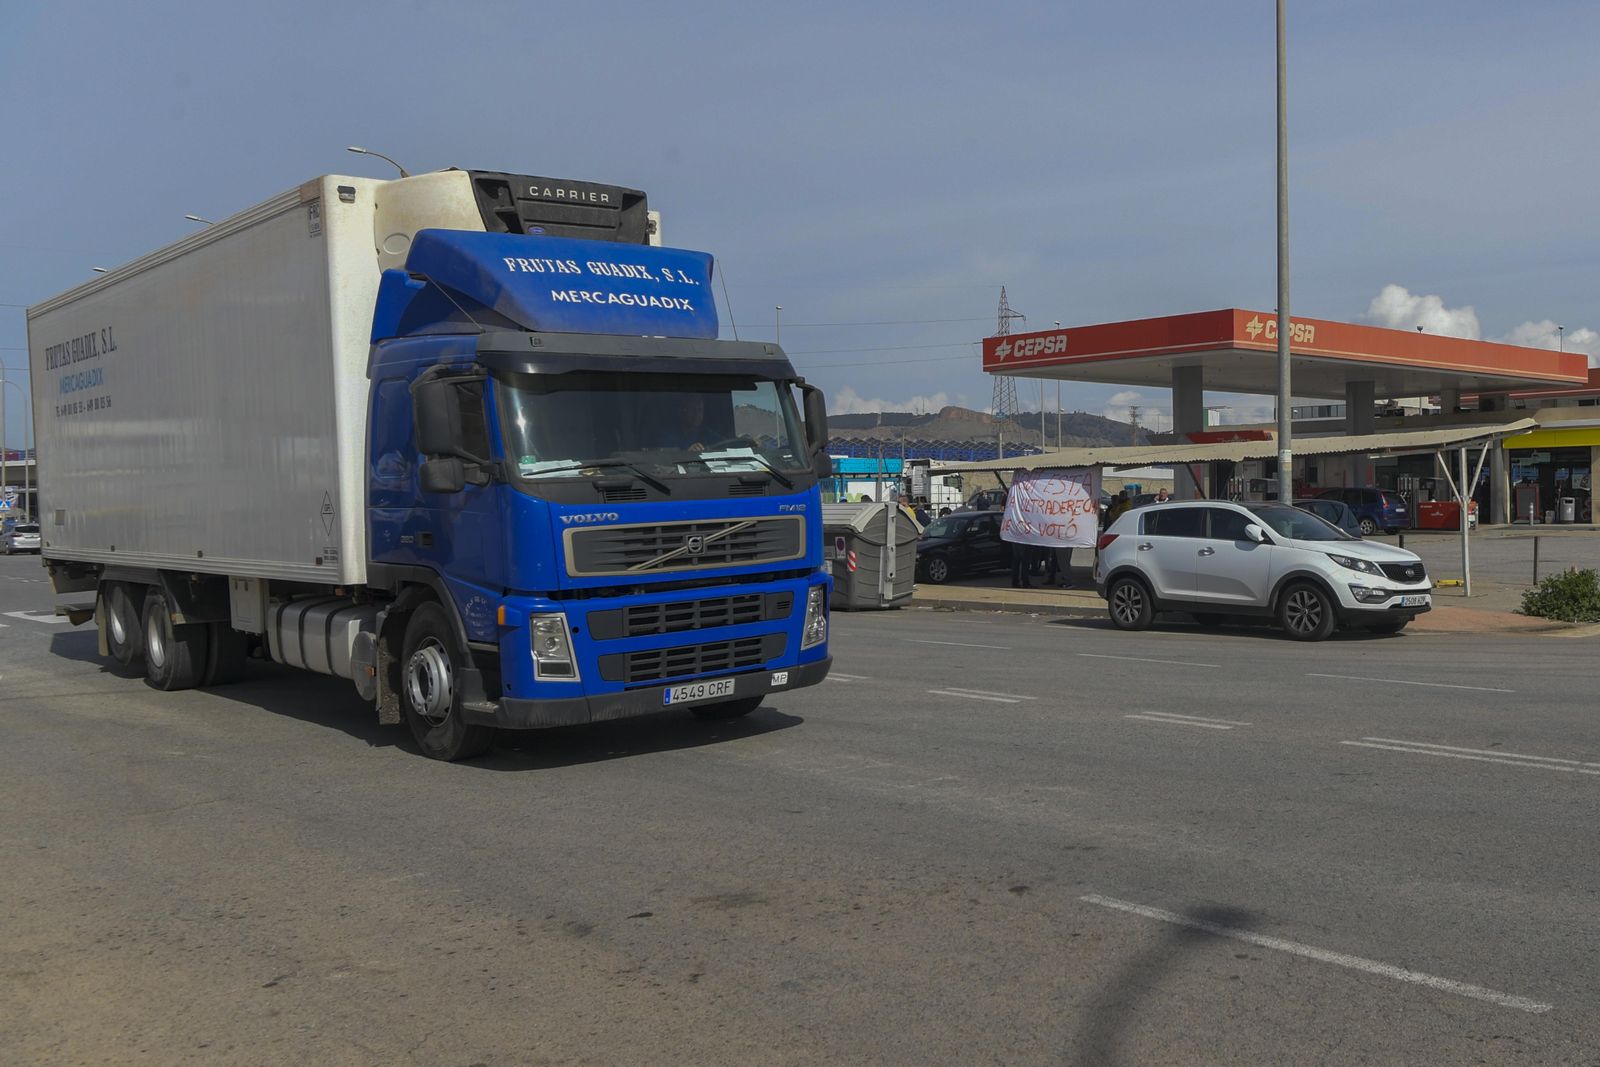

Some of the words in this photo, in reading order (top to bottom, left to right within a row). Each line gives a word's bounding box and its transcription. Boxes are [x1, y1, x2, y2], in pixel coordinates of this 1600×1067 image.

[529, 186, 609, 203] CARRIER
[503, 257, 581, 274] FRUTAS
[586, 261, 660, 283] GUADIX,
[551, 290, 694, 311] MERCAGUADIX
[1265, 320, 1315, 344] CPSA
[45, 341, 71, 371] FRUTAS
[1013, 335, 1067, 358] CEPSA
[60, 368, 104, 394] MERCAGUADIX
[560, 512, 619, 524] VOLVO
[779, 504, 807, 513] FM12
[772, 673, 787, 684] MP
[672, 685, 704, 701] 4549
[708, 681, 731, 696] CRF
